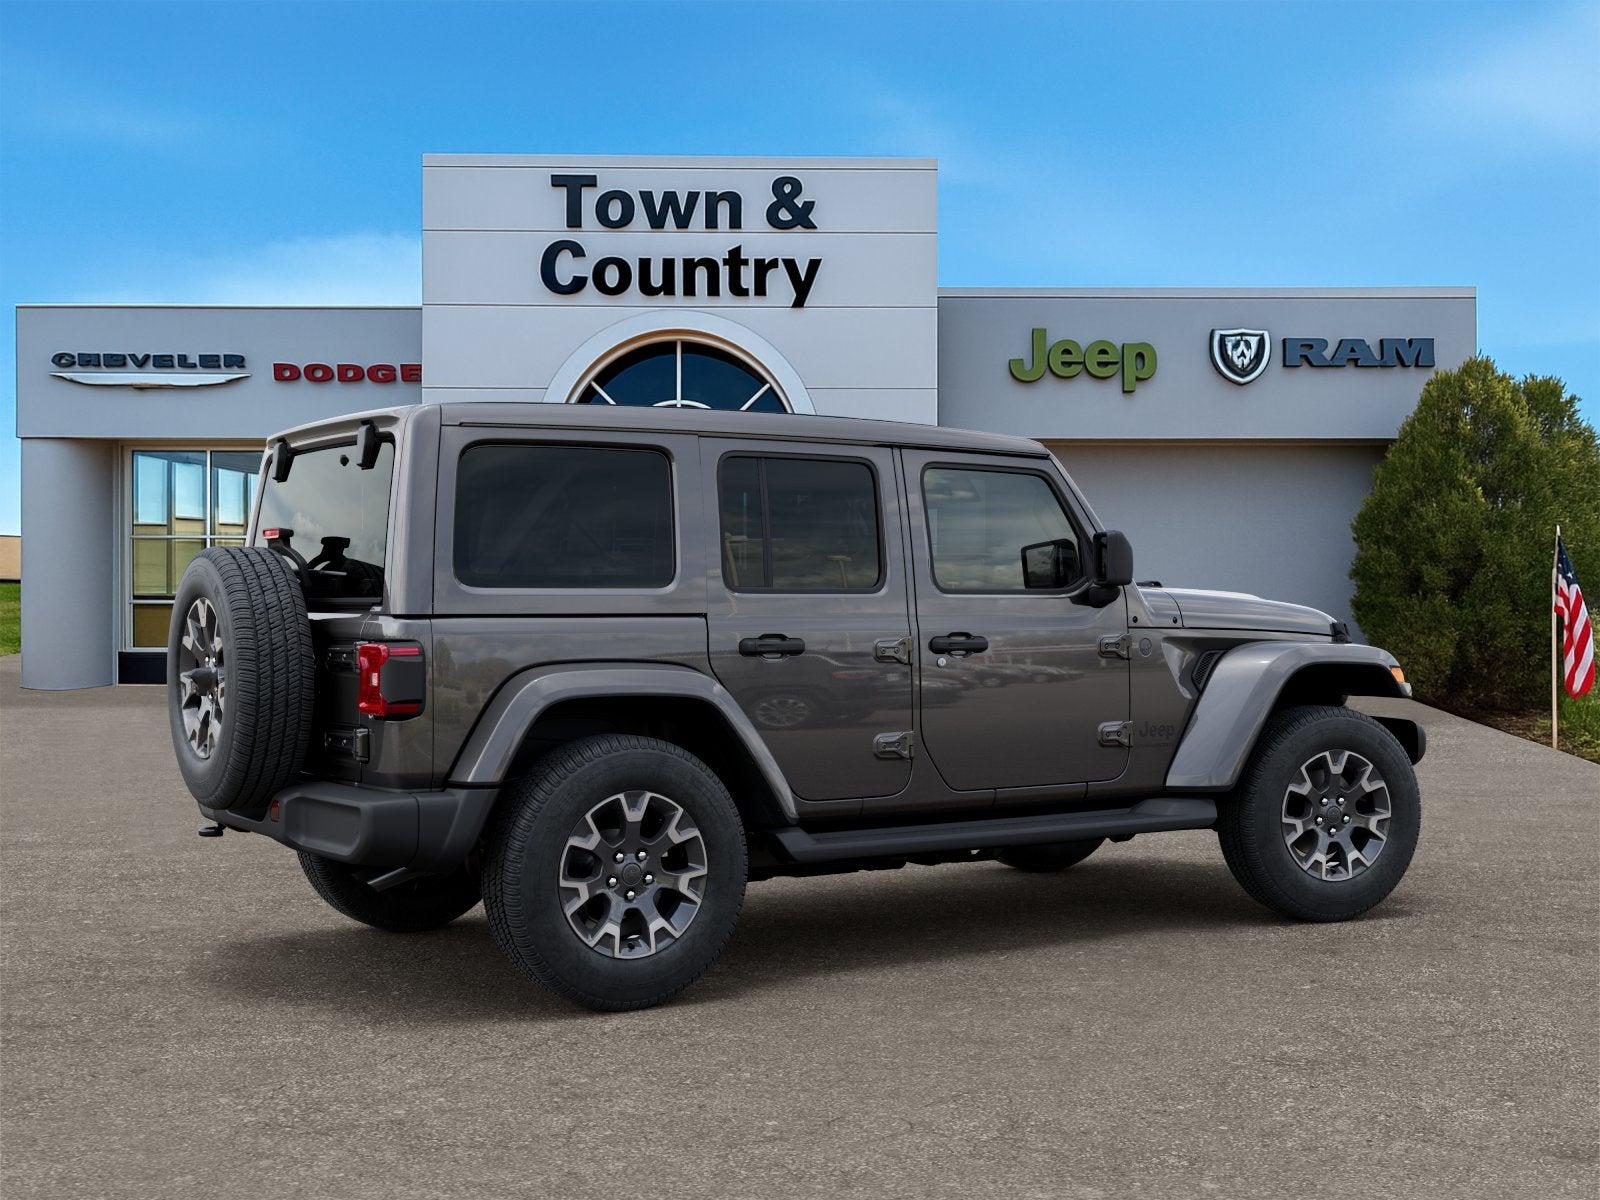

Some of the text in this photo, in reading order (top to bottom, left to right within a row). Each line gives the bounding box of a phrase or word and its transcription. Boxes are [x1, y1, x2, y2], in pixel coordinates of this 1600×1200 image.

[550, 174, 818, 230] Town &
[540, 239, 822, 308] Country
[272, 363, 422, 383] DODGE
[1009, 328, 1158, 393] Jeep
[1283, 338, 1436, 368] RAM
[1139, 721, 1175, 739] Jeep
